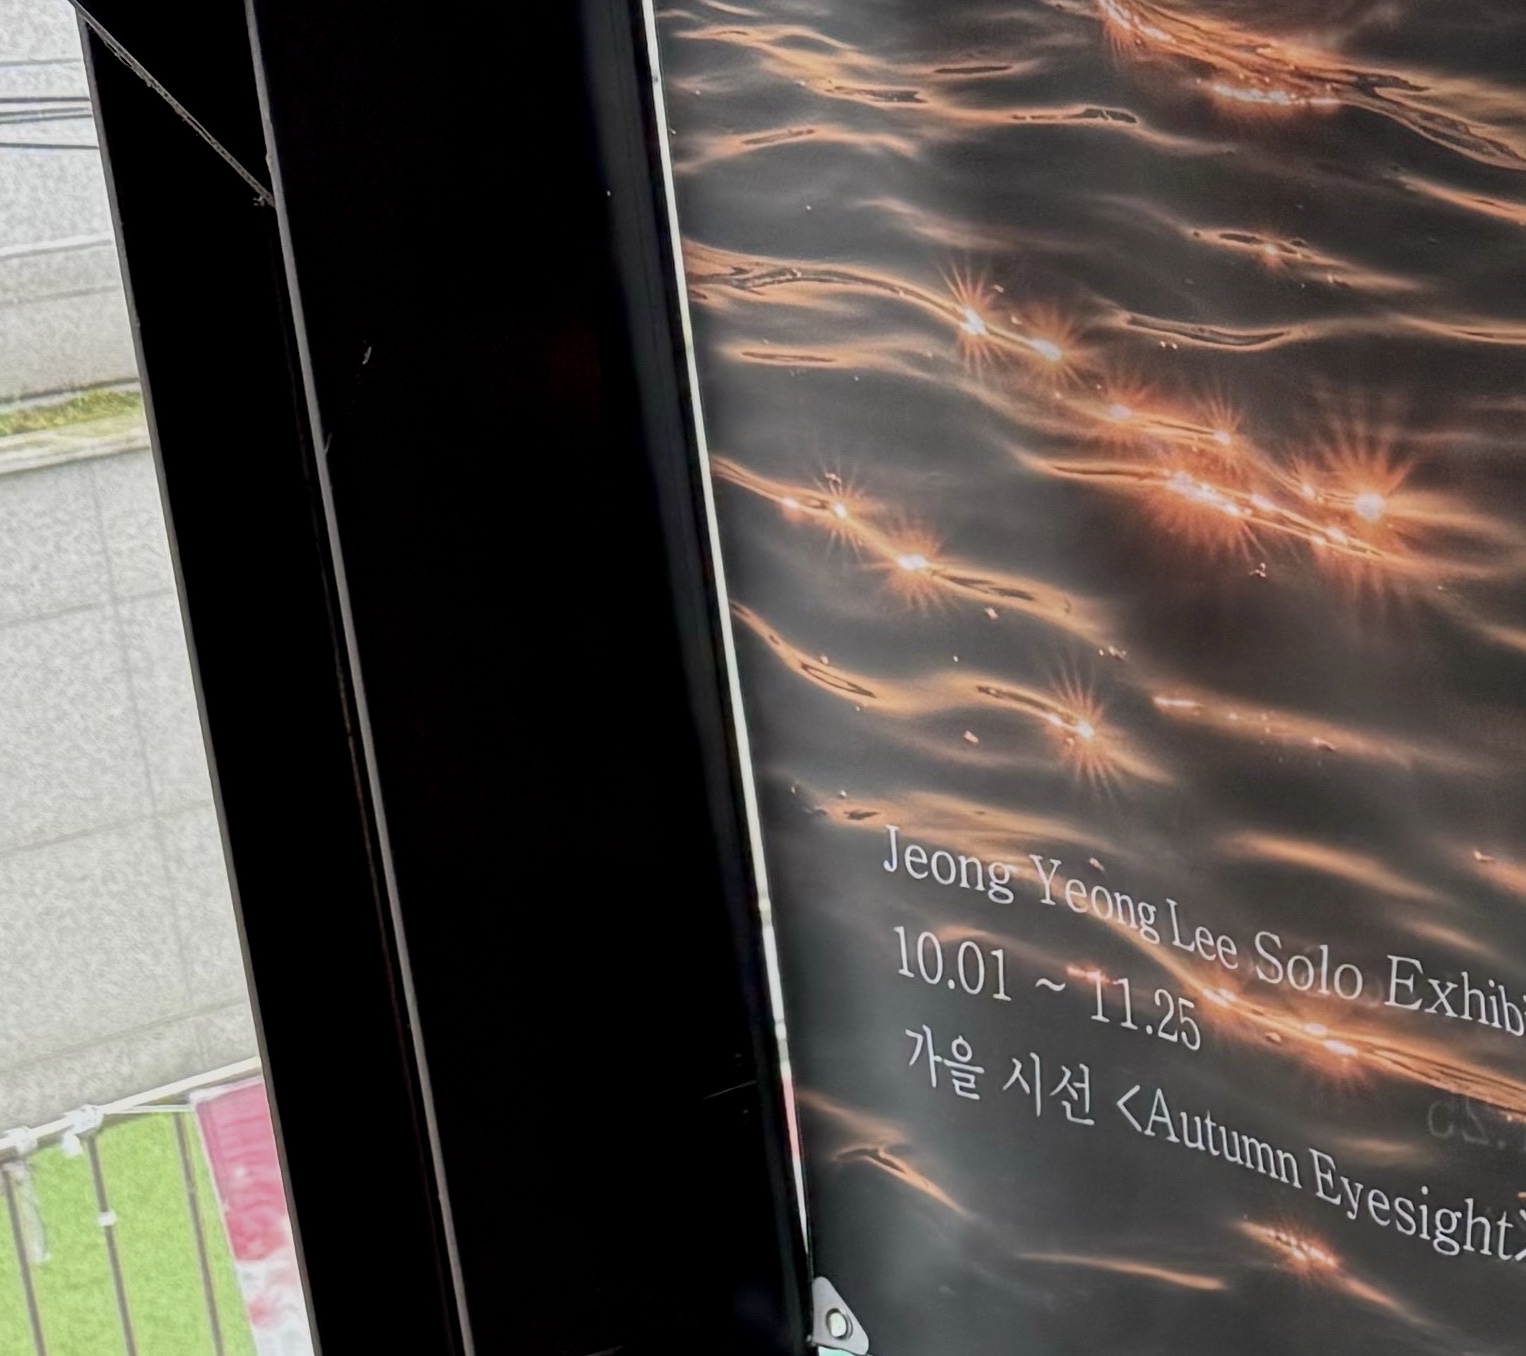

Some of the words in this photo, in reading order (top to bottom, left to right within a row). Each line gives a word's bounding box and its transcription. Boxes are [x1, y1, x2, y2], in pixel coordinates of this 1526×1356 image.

[884, 825, 1015, 905] Jeong
[1029, 853, 1161, 946] Yeong
[1166, 898, 1239, 970] Lee
[1254, 930, 1364, 1001] Solo
[893, 926, 1012, 1002] 10.01
[1091, 969, 1201, 1051] 11.25
[905, 1024, 985, 1101] 가을
[1002, 1051, 1095, 1126] 시선
[1116, 1084, 1303, 1189] <Autumn
